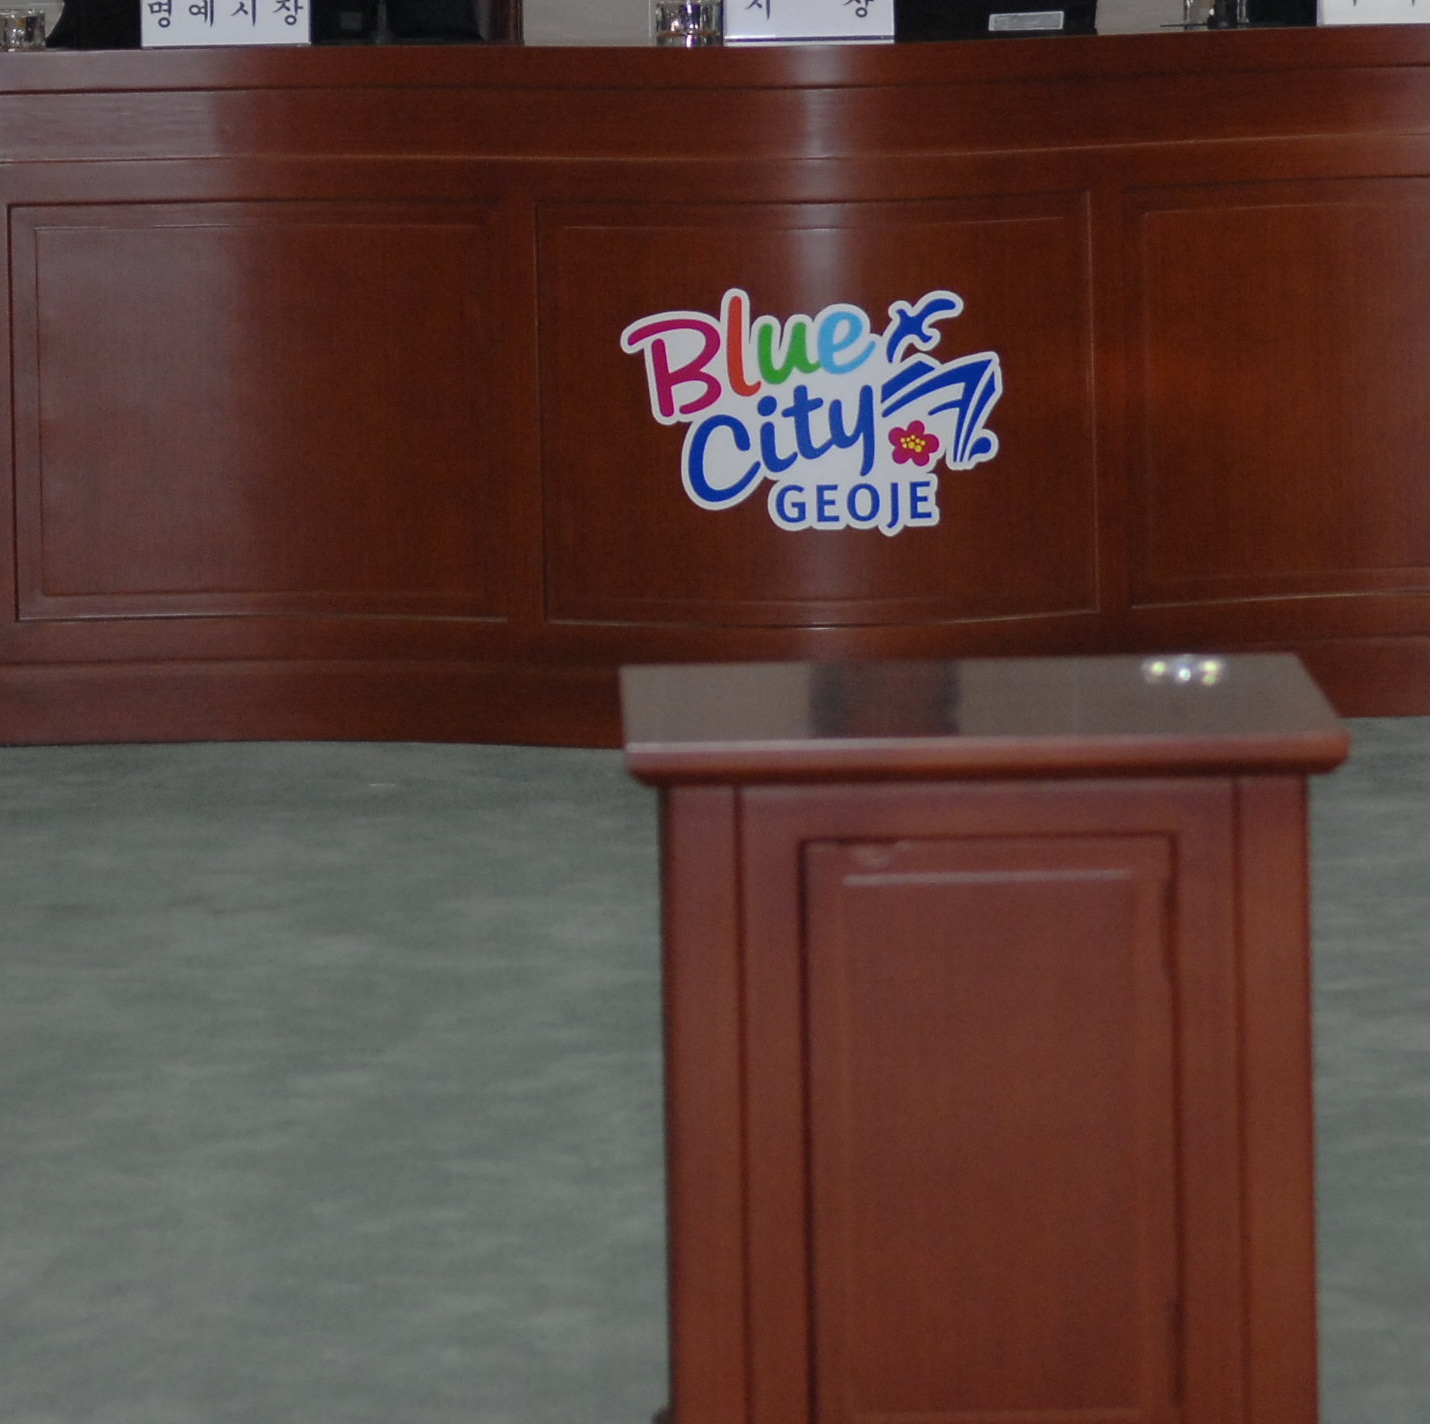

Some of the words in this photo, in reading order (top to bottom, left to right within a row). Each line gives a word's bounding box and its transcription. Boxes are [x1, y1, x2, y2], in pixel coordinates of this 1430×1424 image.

[626, 294, 876, 419] Blue
[687, 383, 875, 504] City
[774, 479, 934, 529] GEOJE
